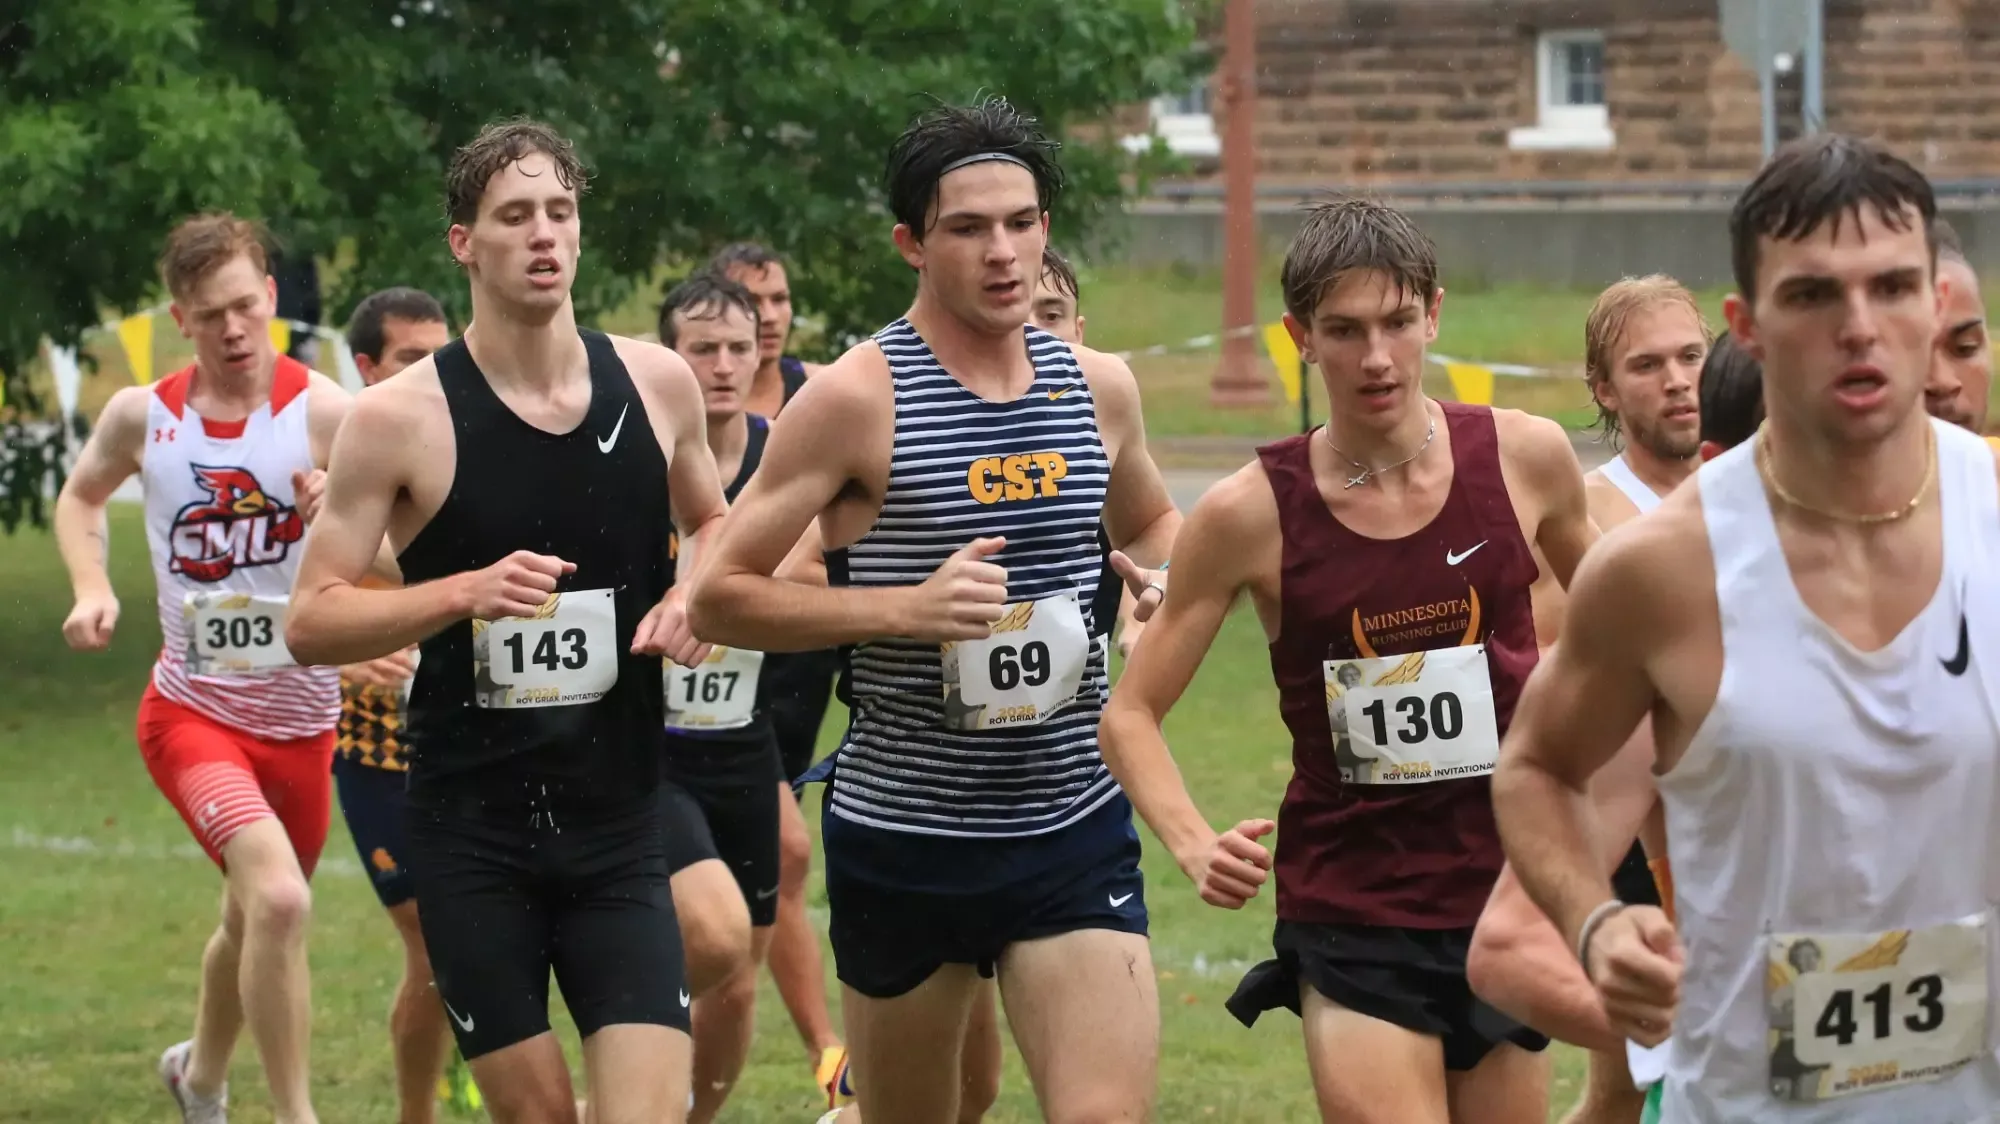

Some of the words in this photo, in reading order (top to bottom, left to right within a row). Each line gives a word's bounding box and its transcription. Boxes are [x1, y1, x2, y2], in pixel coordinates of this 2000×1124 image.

[967, 451, 1068, 505] CSP
[1363, 598, 1471, 632] MINNESOTA
[206, 616, 274, 648] 303
[1371, 626, 1433, 646] RUNNING
[1436, 619, 1468, 634] CLUB
[503, 627, 589, 674] 143
[988, 640, 1051, 691] 69
[516, 696, 533, 705] ROY
[682, 671, 740, 703] 167
[989, 715, 1008, 725] ROY
[1010, 712, 1037, 723] GRIAK
[1362, 691, 1464, 746] 130
[1383, 772, 1401, 780] ROY
[1403, 770, 1432, 780] GRIAK
[1814, 974, 1945, 1046] 413
